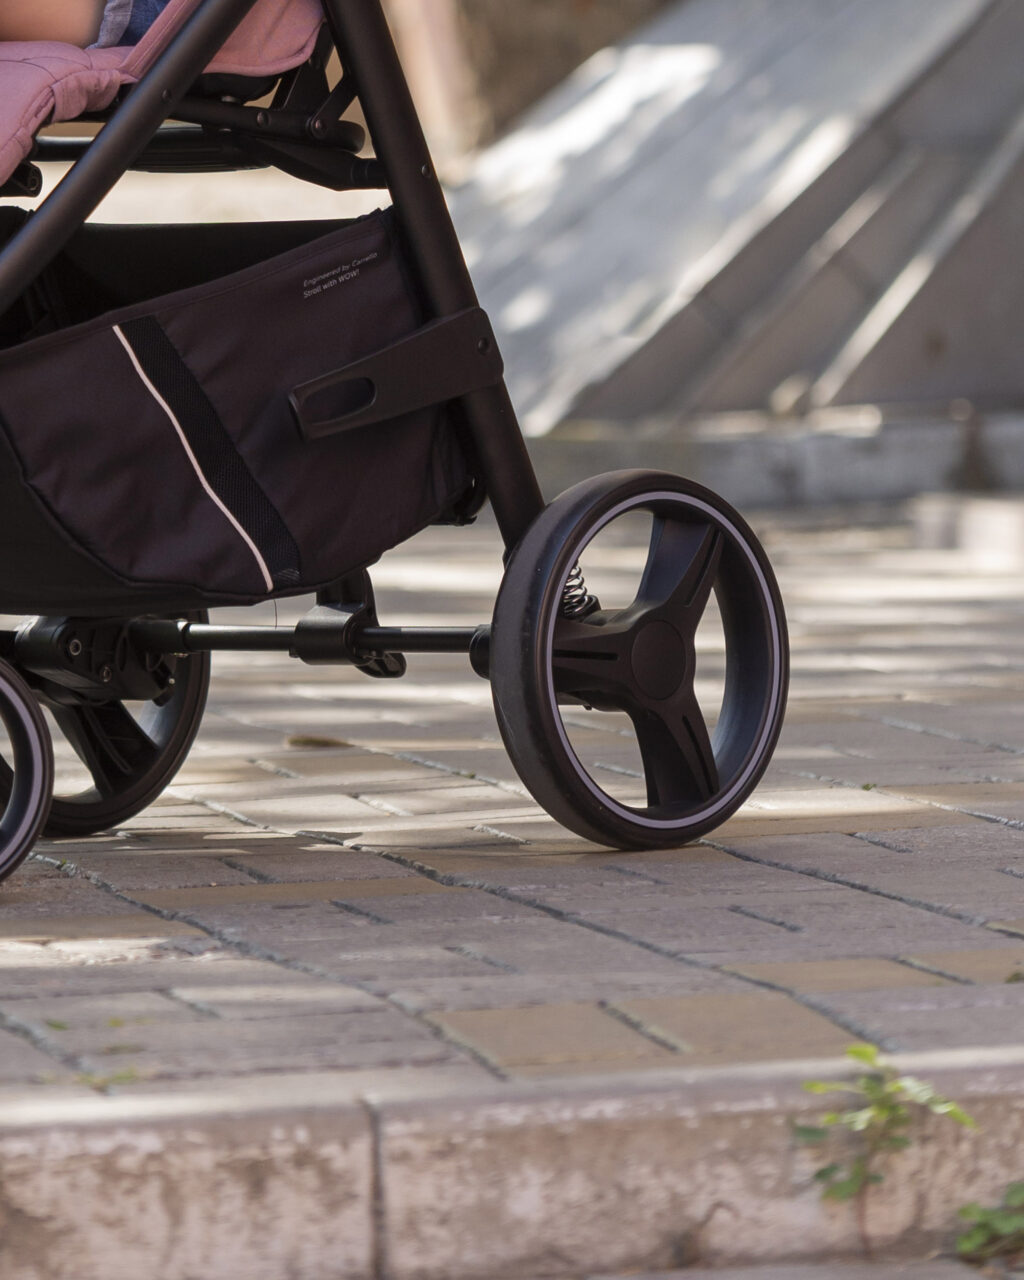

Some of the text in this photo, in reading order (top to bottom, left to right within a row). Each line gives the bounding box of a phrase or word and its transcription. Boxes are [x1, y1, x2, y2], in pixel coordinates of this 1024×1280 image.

[303, 266, 341, 287] Engineered
[341, 264, 351, 272] by
[303, 268, 360, 299] Stroll with WOW!
